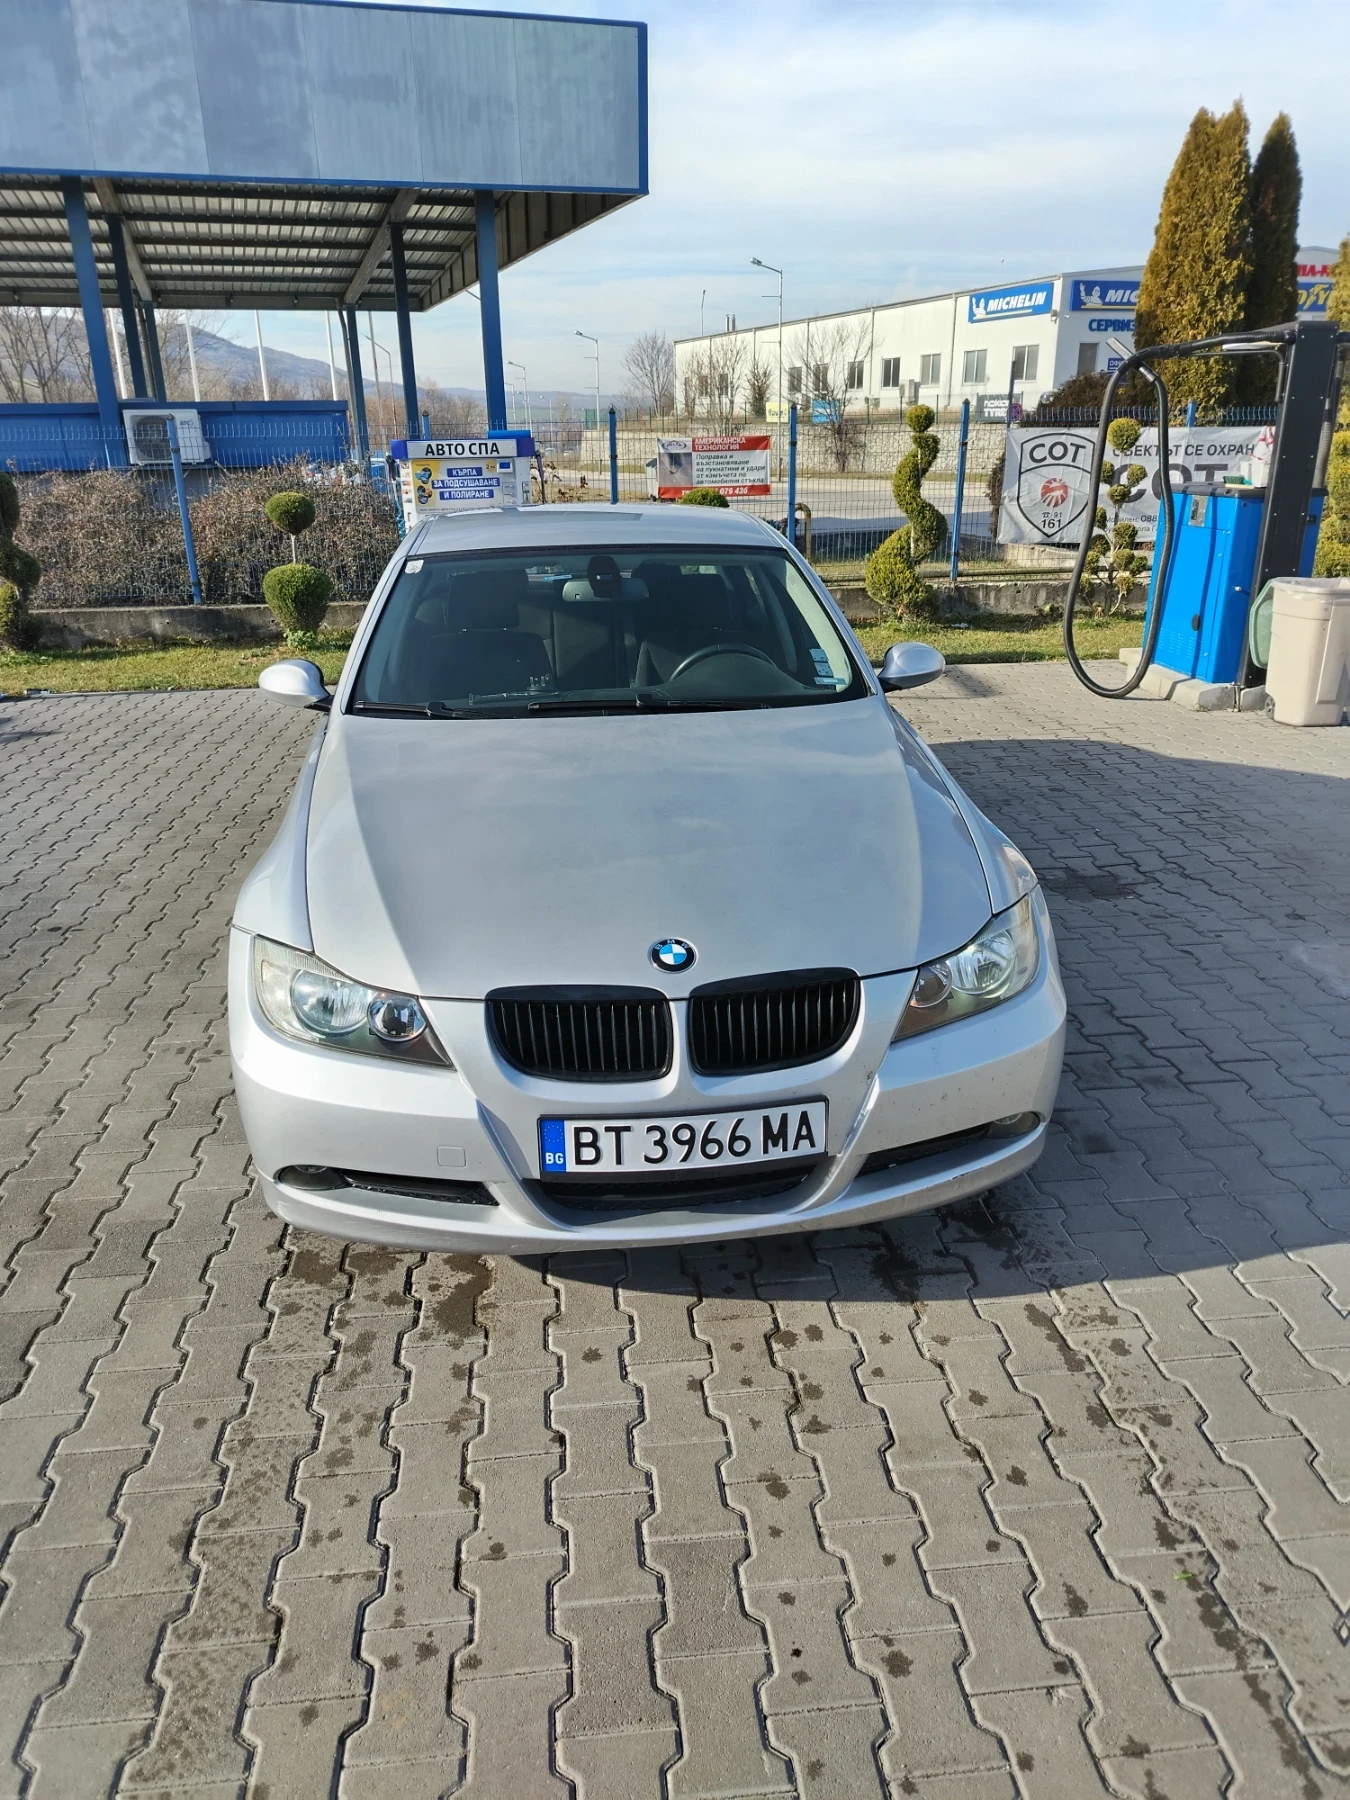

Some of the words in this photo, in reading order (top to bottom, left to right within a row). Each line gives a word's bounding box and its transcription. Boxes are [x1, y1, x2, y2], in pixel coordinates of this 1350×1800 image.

[987, 291, 1047, 312] MICHELIN
[425, 443, 465, 456] АВТО
[468, 442, 500, 455] СПА
[1029, 441, 1087, 463] СОТ
[1185, 444, 1204, 456] СЕ
[1207, 443, 1254, 456] ОХРАН
[452, 468, 478, 476] КЪРПА
[433, 480, 443, 488] ЗА
[444, 478, 499, 488] ПОДСУШАВАНЕ
[451, 490, 490, 499] ПОЛИРАНЕ
[1041, 518, 1062, 529] 161
[654, 938, 690, 950] BMW
[545, 1152, 564, 1165] BG
[572, 1125, 633, 1166] BT
[643, 1117, 752, 1165] 3966
[761, 1110, 817, 1156] MA
